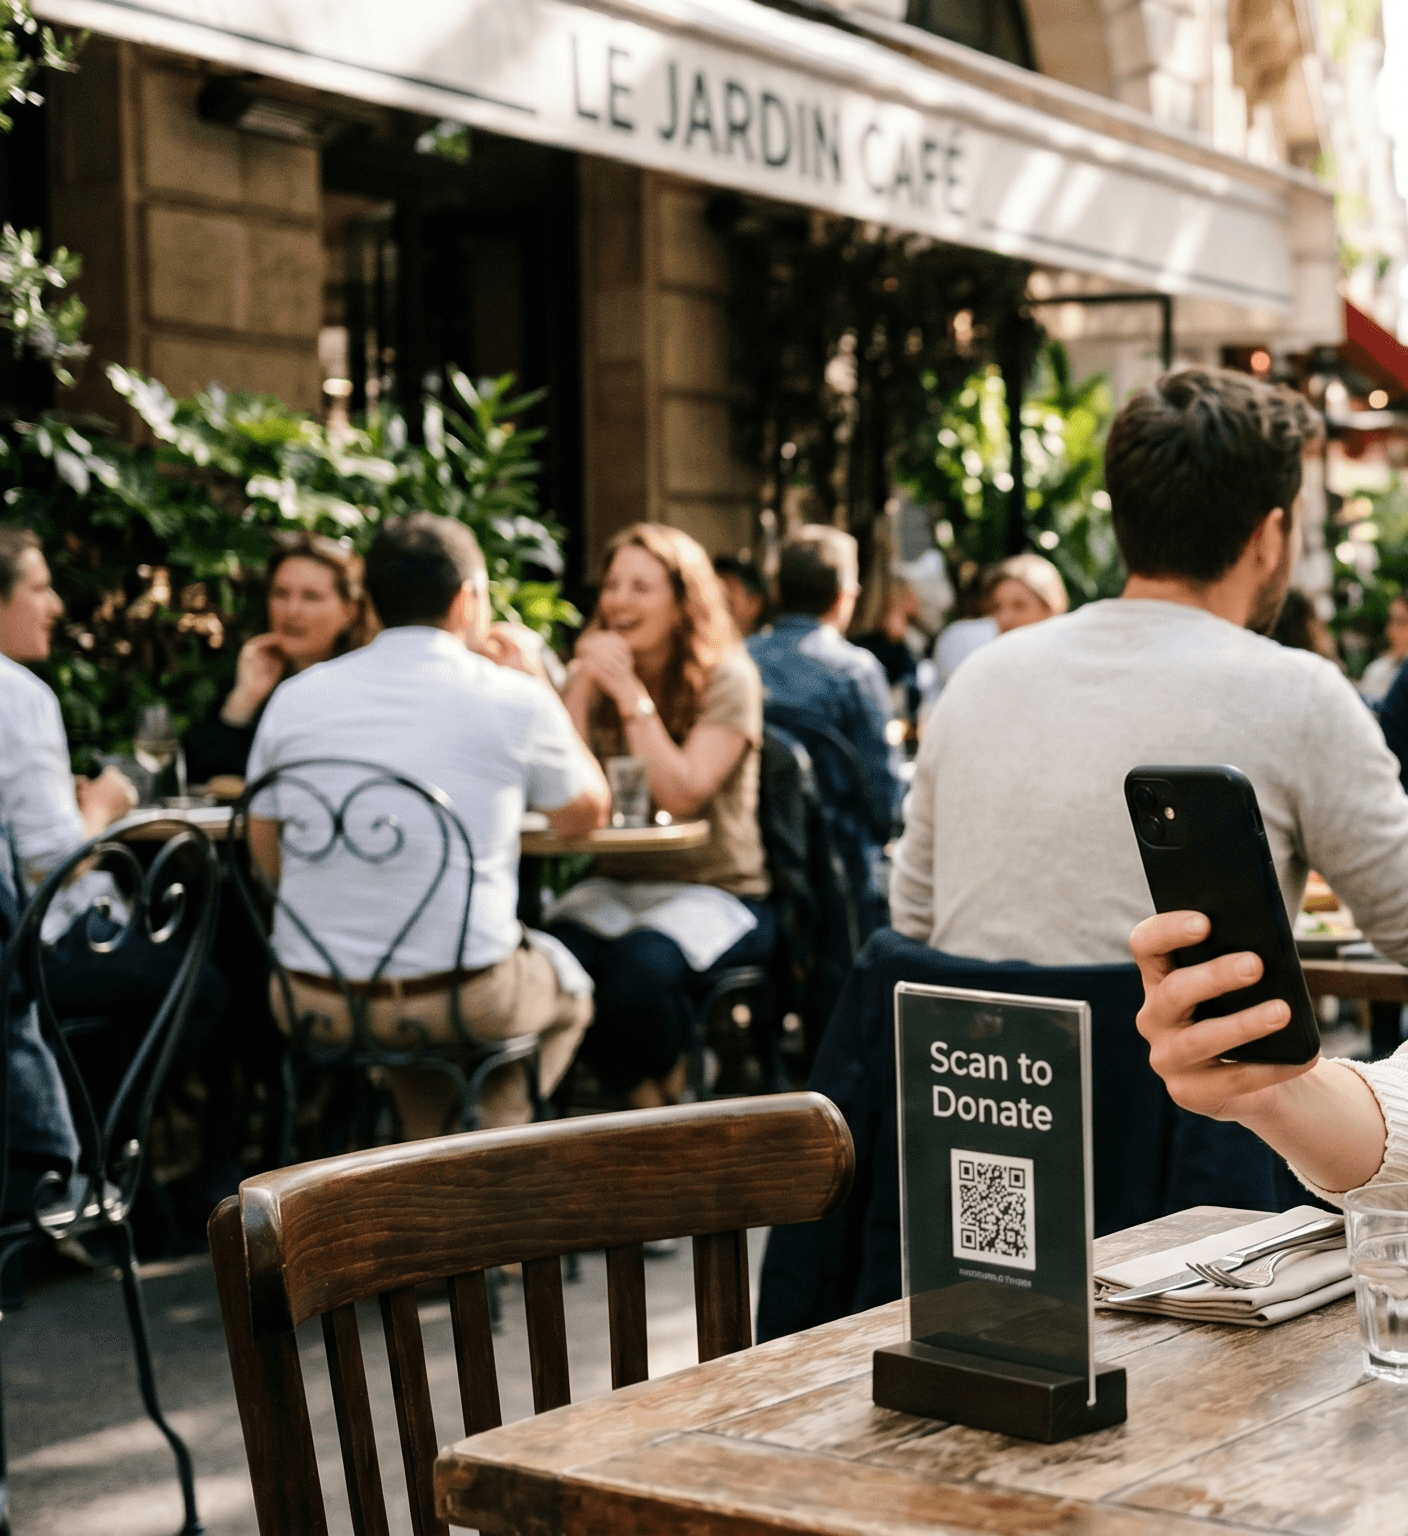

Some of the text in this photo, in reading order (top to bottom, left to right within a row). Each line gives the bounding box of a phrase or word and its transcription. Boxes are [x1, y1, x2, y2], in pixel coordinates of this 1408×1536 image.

[570, 33, 968, 217] LE JARDIN CAFÉ
[930, 1041, 1053, 1086] Scan to
[932, 1085, 1053, 1131] Donate
